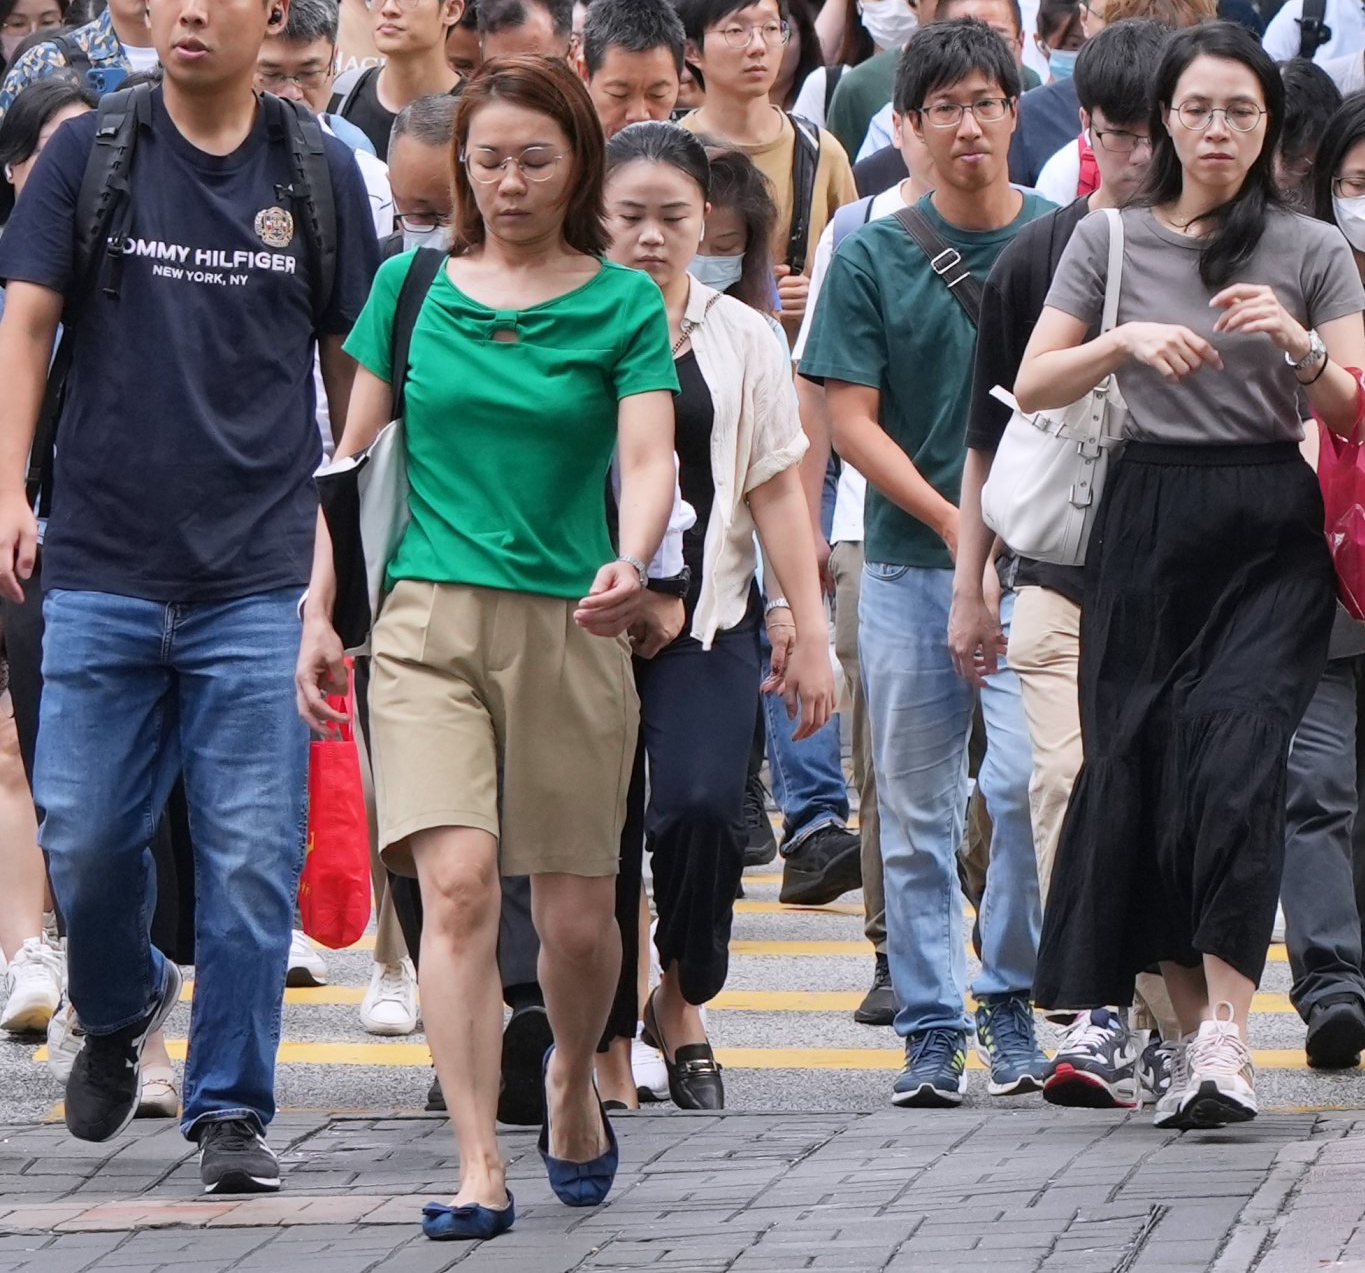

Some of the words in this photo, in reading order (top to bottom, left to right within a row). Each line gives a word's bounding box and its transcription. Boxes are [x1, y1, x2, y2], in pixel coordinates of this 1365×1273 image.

[108, 238, 190, 263] OMMY
[195, 249, 296, 274] HILFIGER
[153, 265, 184, 279] NEW
[186, 271, 226, 286] YORK,
[230, 274, 249, 286] NY
